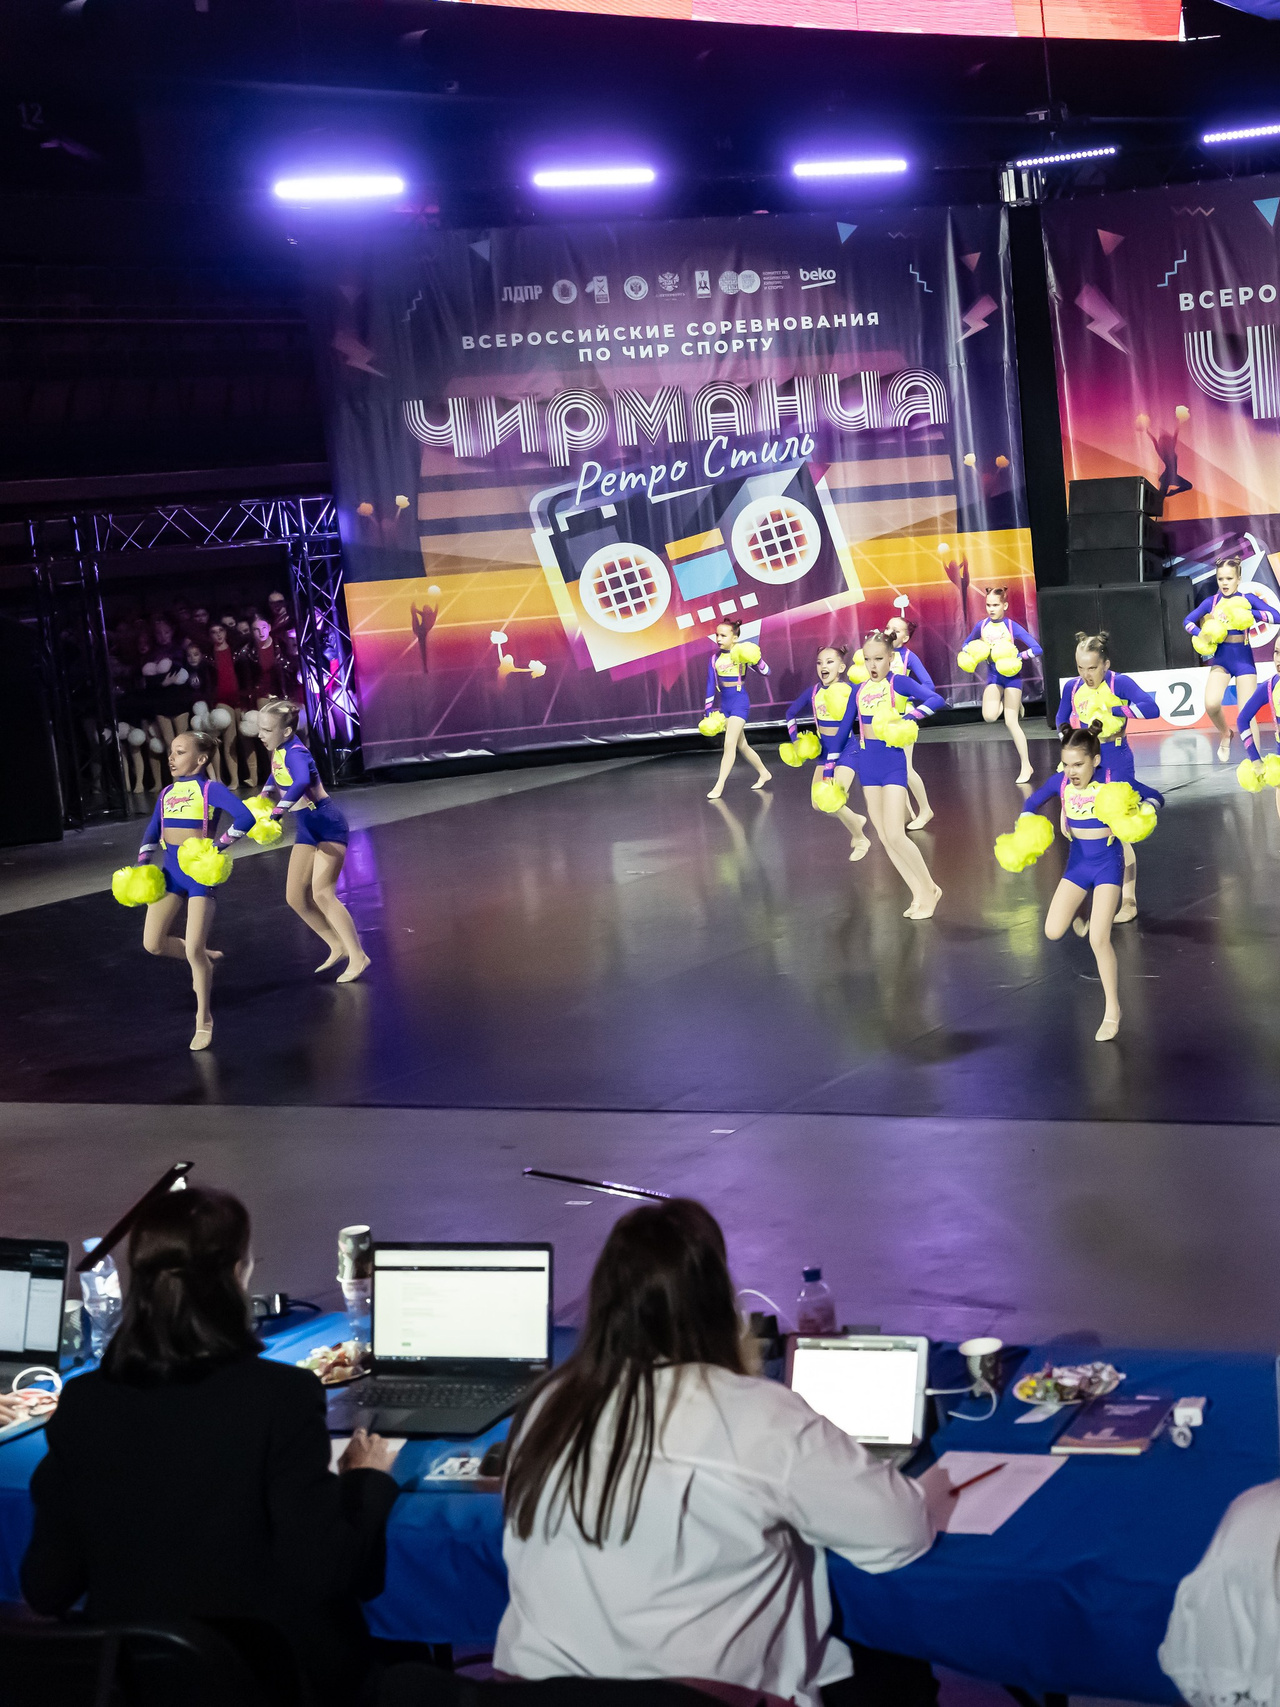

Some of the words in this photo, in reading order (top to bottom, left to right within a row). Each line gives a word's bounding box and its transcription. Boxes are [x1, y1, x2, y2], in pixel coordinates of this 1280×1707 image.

[16, 102, 44, 123] 12
[800, 267, 837, 282] beko
[501, 285, 543, 303] ЛДПР
[462, 323, 676, 350] ВСЕРОССИЙСКИЕ
[686, 312, 880, 337] СОРЕВНОВАНИЯ
[578, 348, 611, 363] ПО
[622, 344, 670, 361] ЧИР
[681, 337, 774, 356] СПОРТУ
[575, 460, 687, 506] Ретро
[703, 435, 815, 478] Стиль
[1168, 681, 1196, 718] 2
